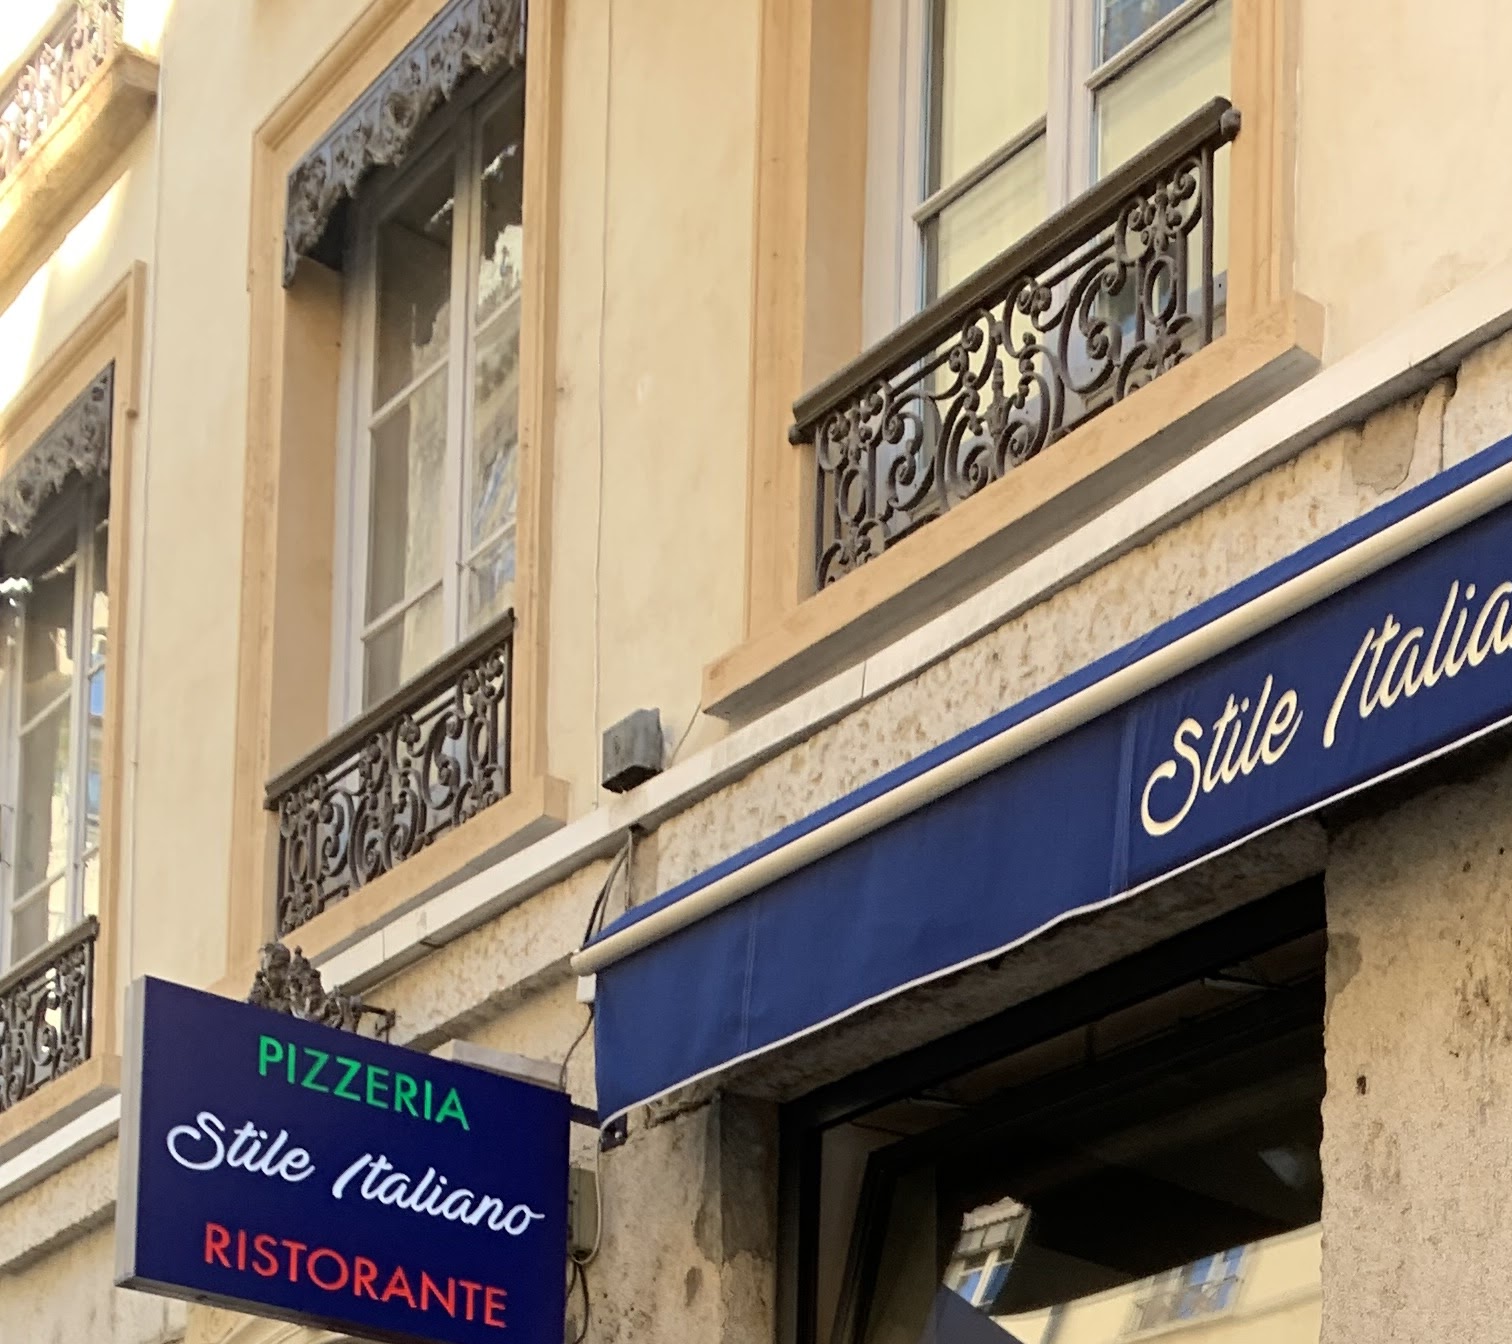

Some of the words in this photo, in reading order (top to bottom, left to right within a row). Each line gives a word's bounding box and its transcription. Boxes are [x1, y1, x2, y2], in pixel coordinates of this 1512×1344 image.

[1141, 675, 1303, 837] Stile
[258, 1036, 469, 1131] PIZZERIA
[166, 1112, 314, 1183] Stile
[332, 1152, 544, 1237] Italiano
[204, 1222, 507, 1329] RISTORANTE
